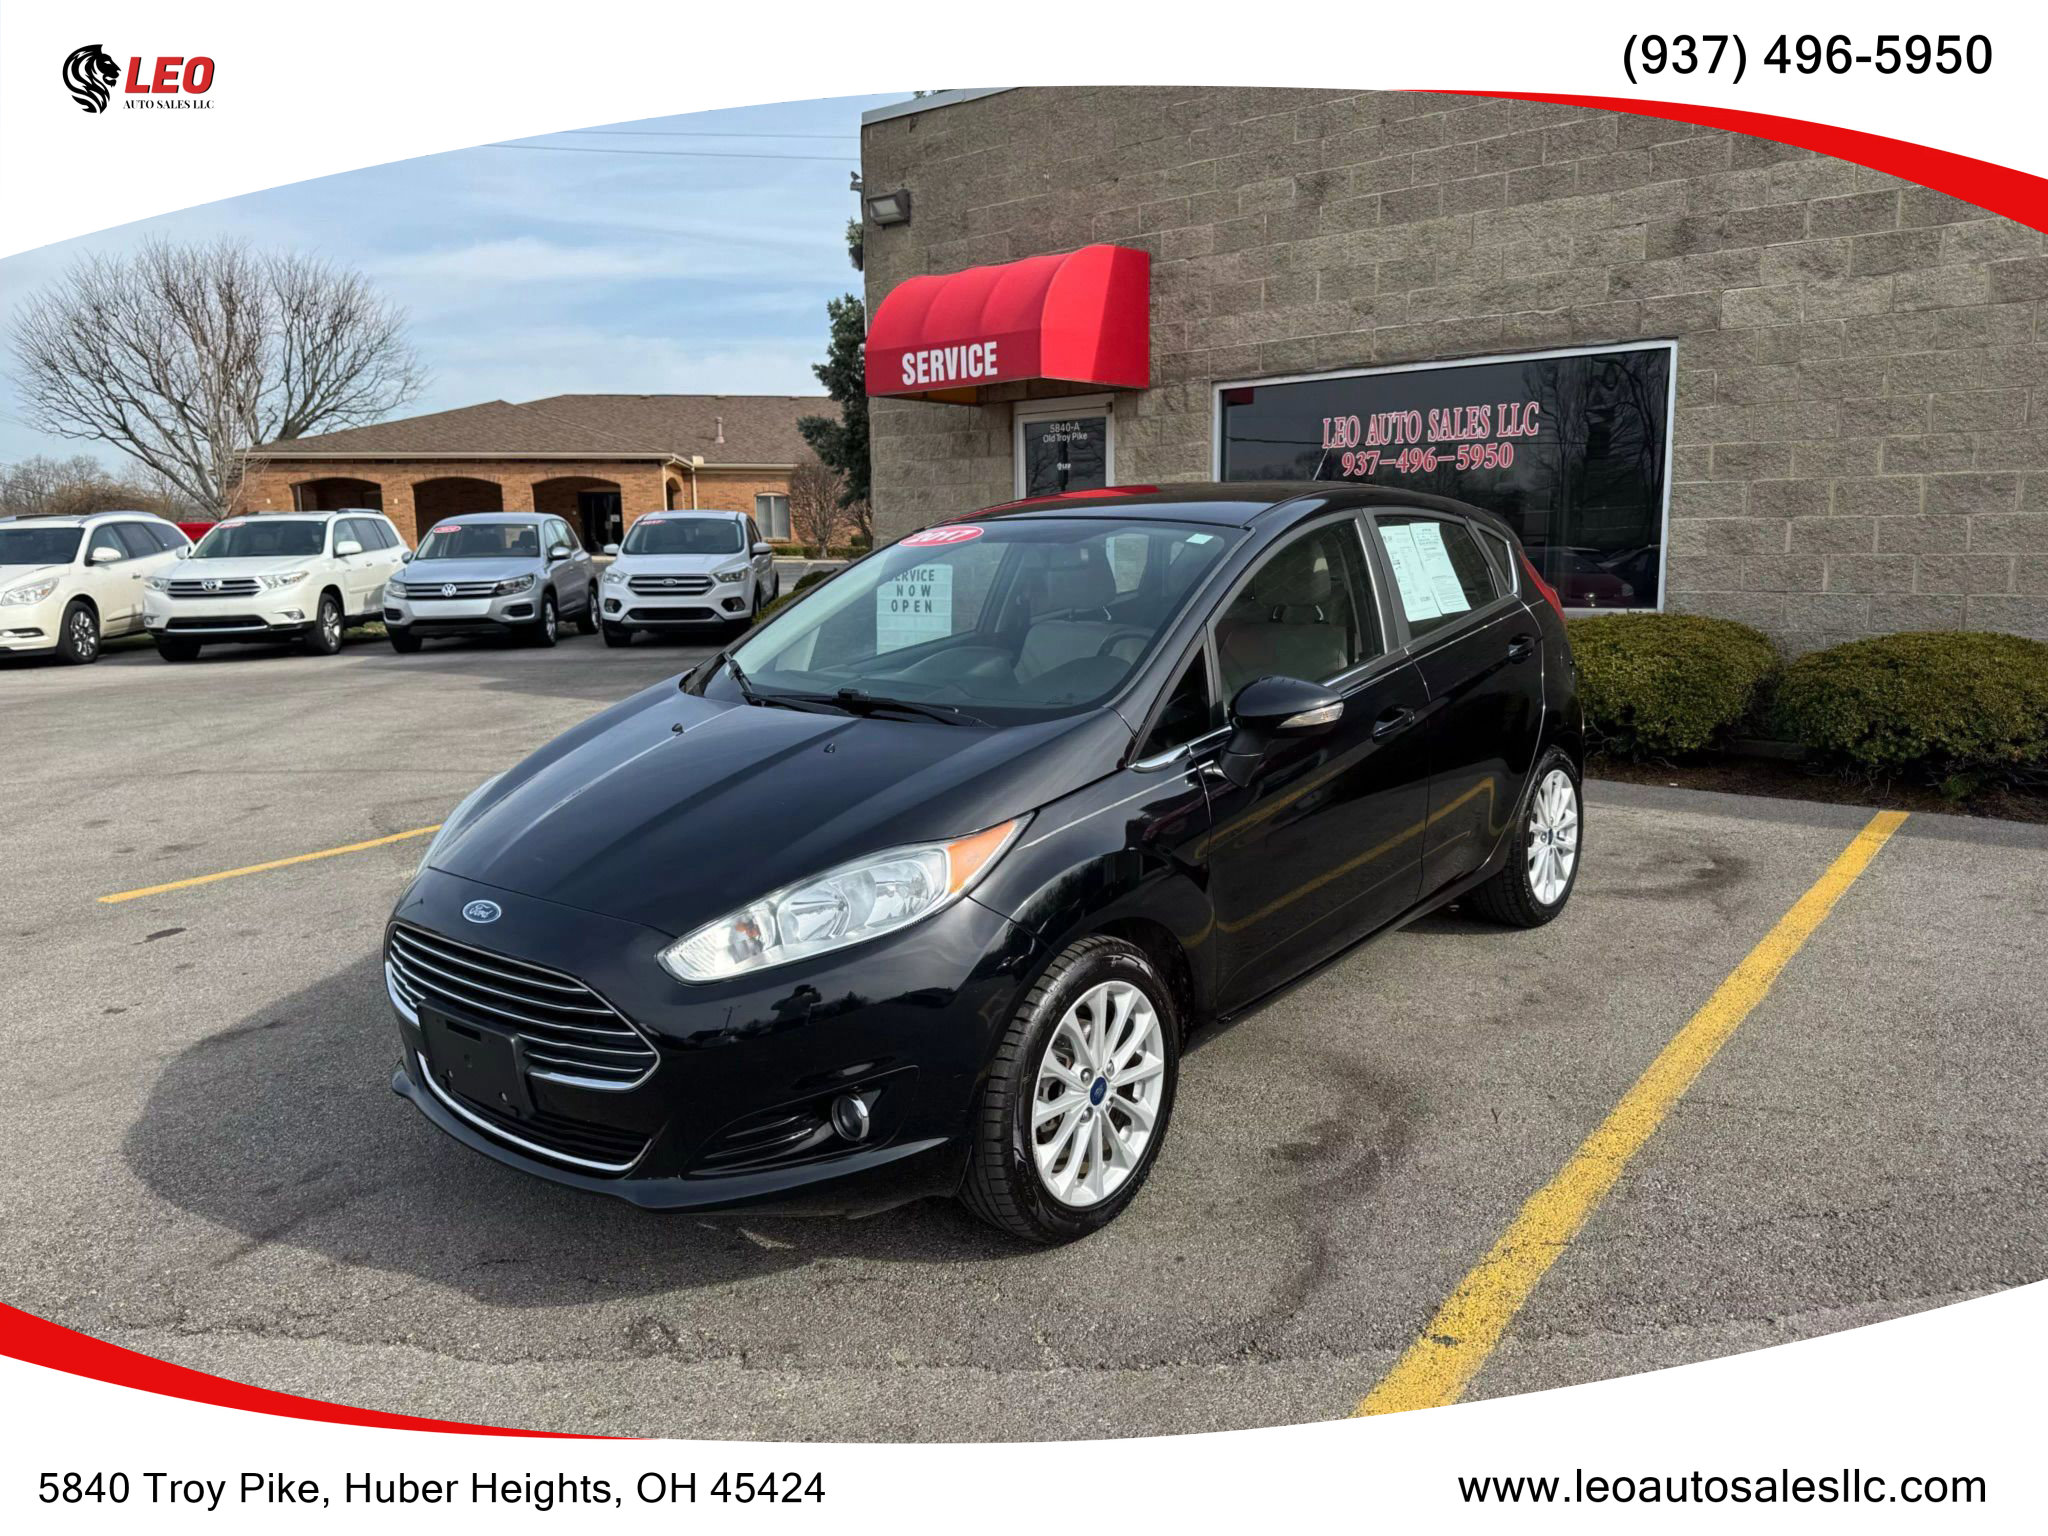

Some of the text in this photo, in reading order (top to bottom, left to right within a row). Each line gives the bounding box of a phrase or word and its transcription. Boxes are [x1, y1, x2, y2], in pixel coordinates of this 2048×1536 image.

[902, 341, 998, 386] SERVICE
[1049, 422, 1080, 433] 5840-A
[1322, 401, 1540, 449] LEO AUTO SALES LLC
[1042, 431, 1088, 443] Old Troy Pike
[1341, 441, 1515, 477] 937-496-5950
[894, 568, 935, 582] ERVICE
[891, 599, 933, 613] OPEN
